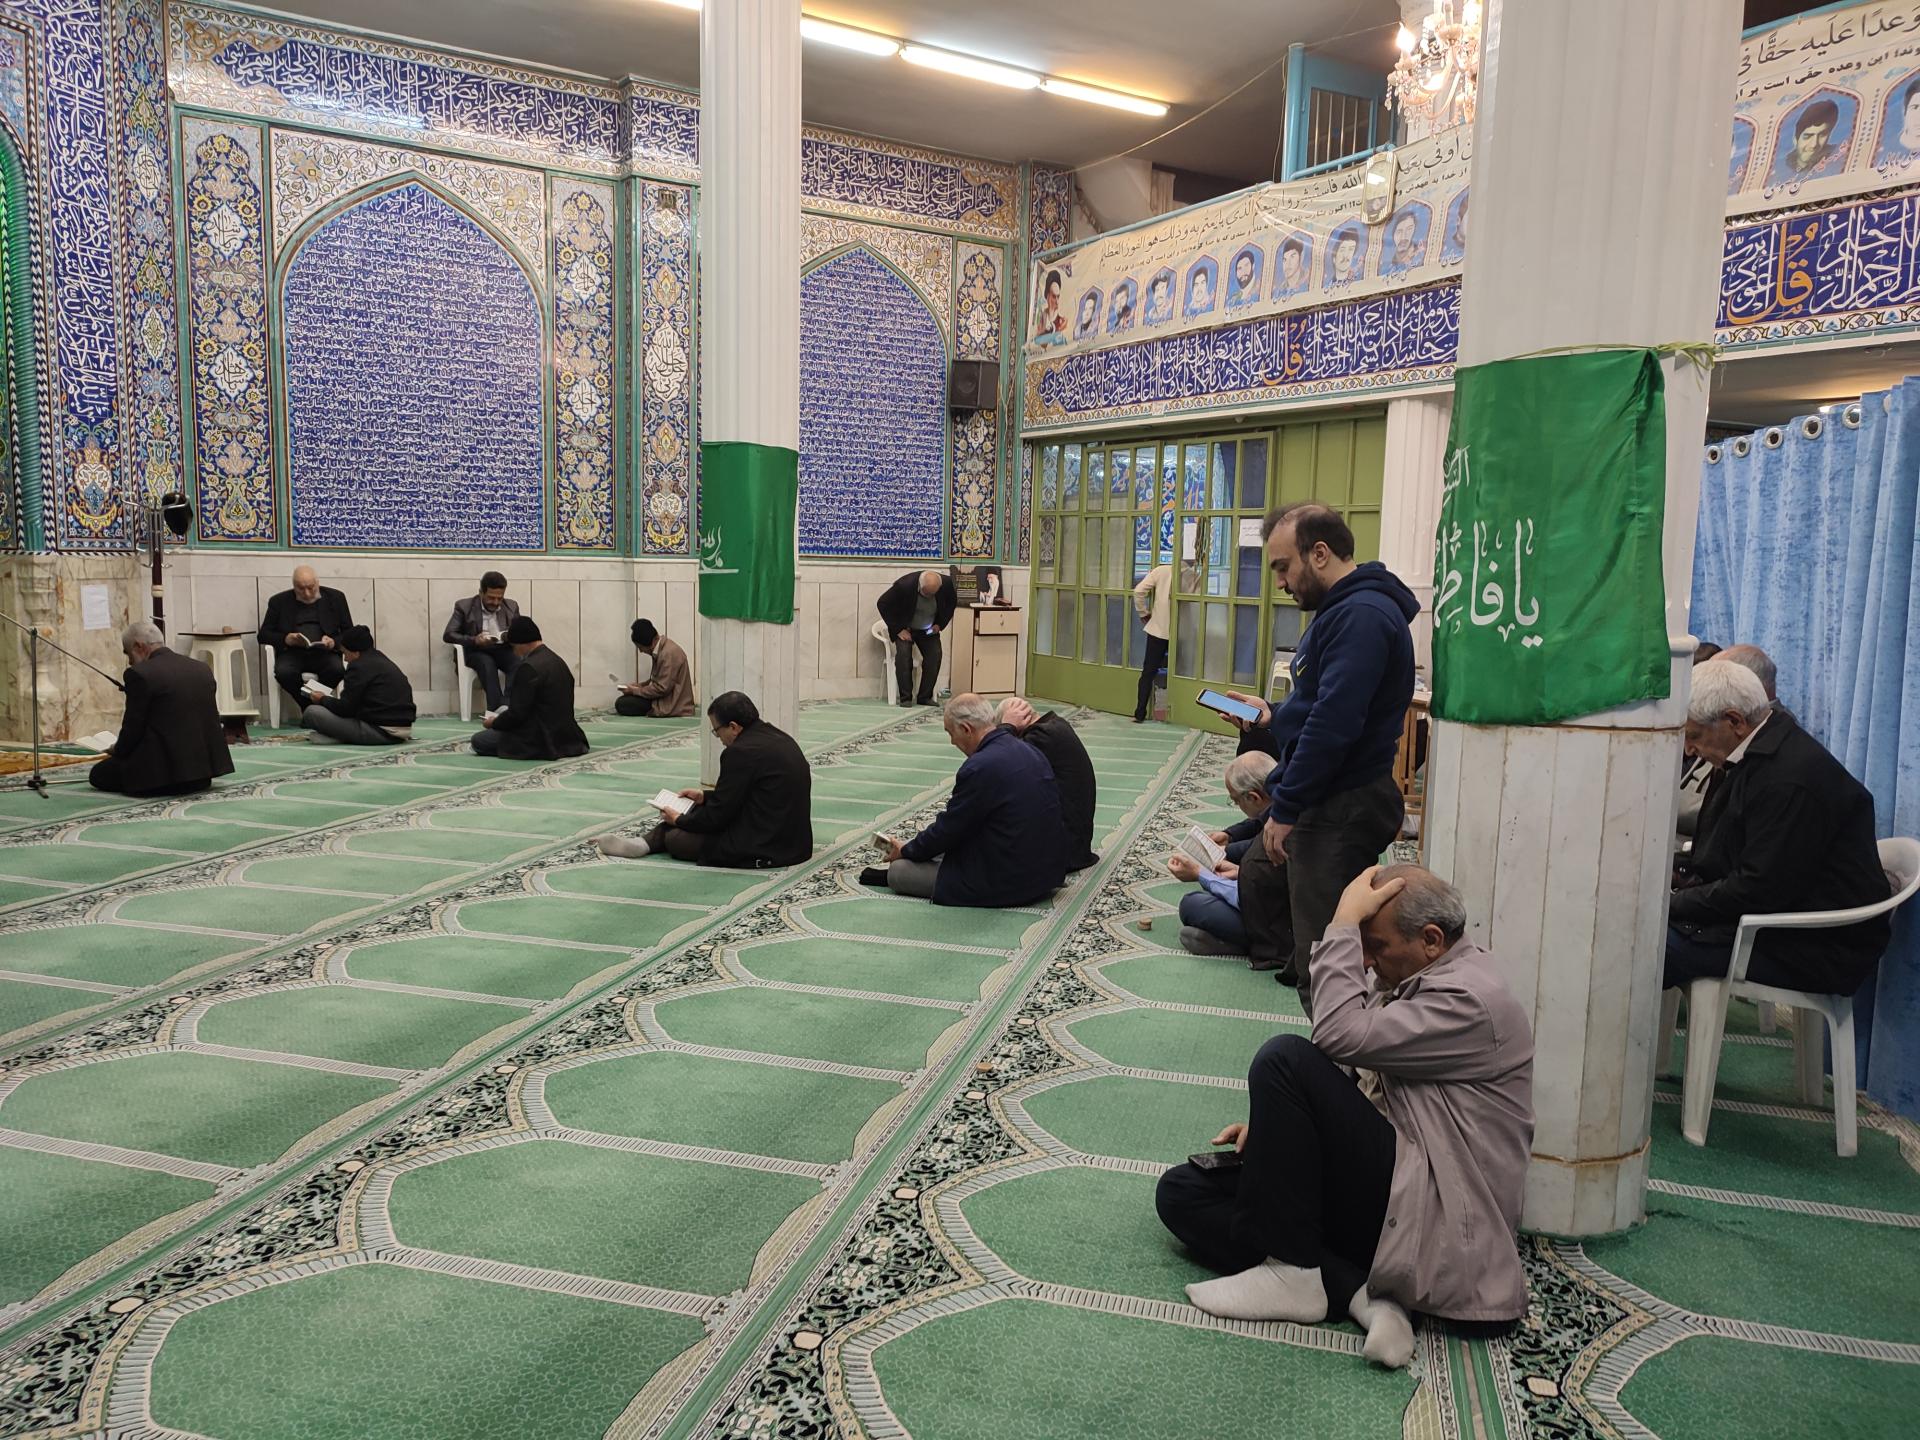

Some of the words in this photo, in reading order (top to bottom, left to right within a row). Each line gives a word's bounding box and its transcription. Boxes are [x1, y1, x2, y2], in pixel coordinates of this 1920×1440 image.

[1867, 52, 1889, 67] این
[1828, 61, 1862, 74] وعده
[1764, 75, 1790, 90] است
[1748, 86, 1759, 97] بر
[1342, 172, 1362, 190] الله
[1442, 172, 1456, 181] خدا
